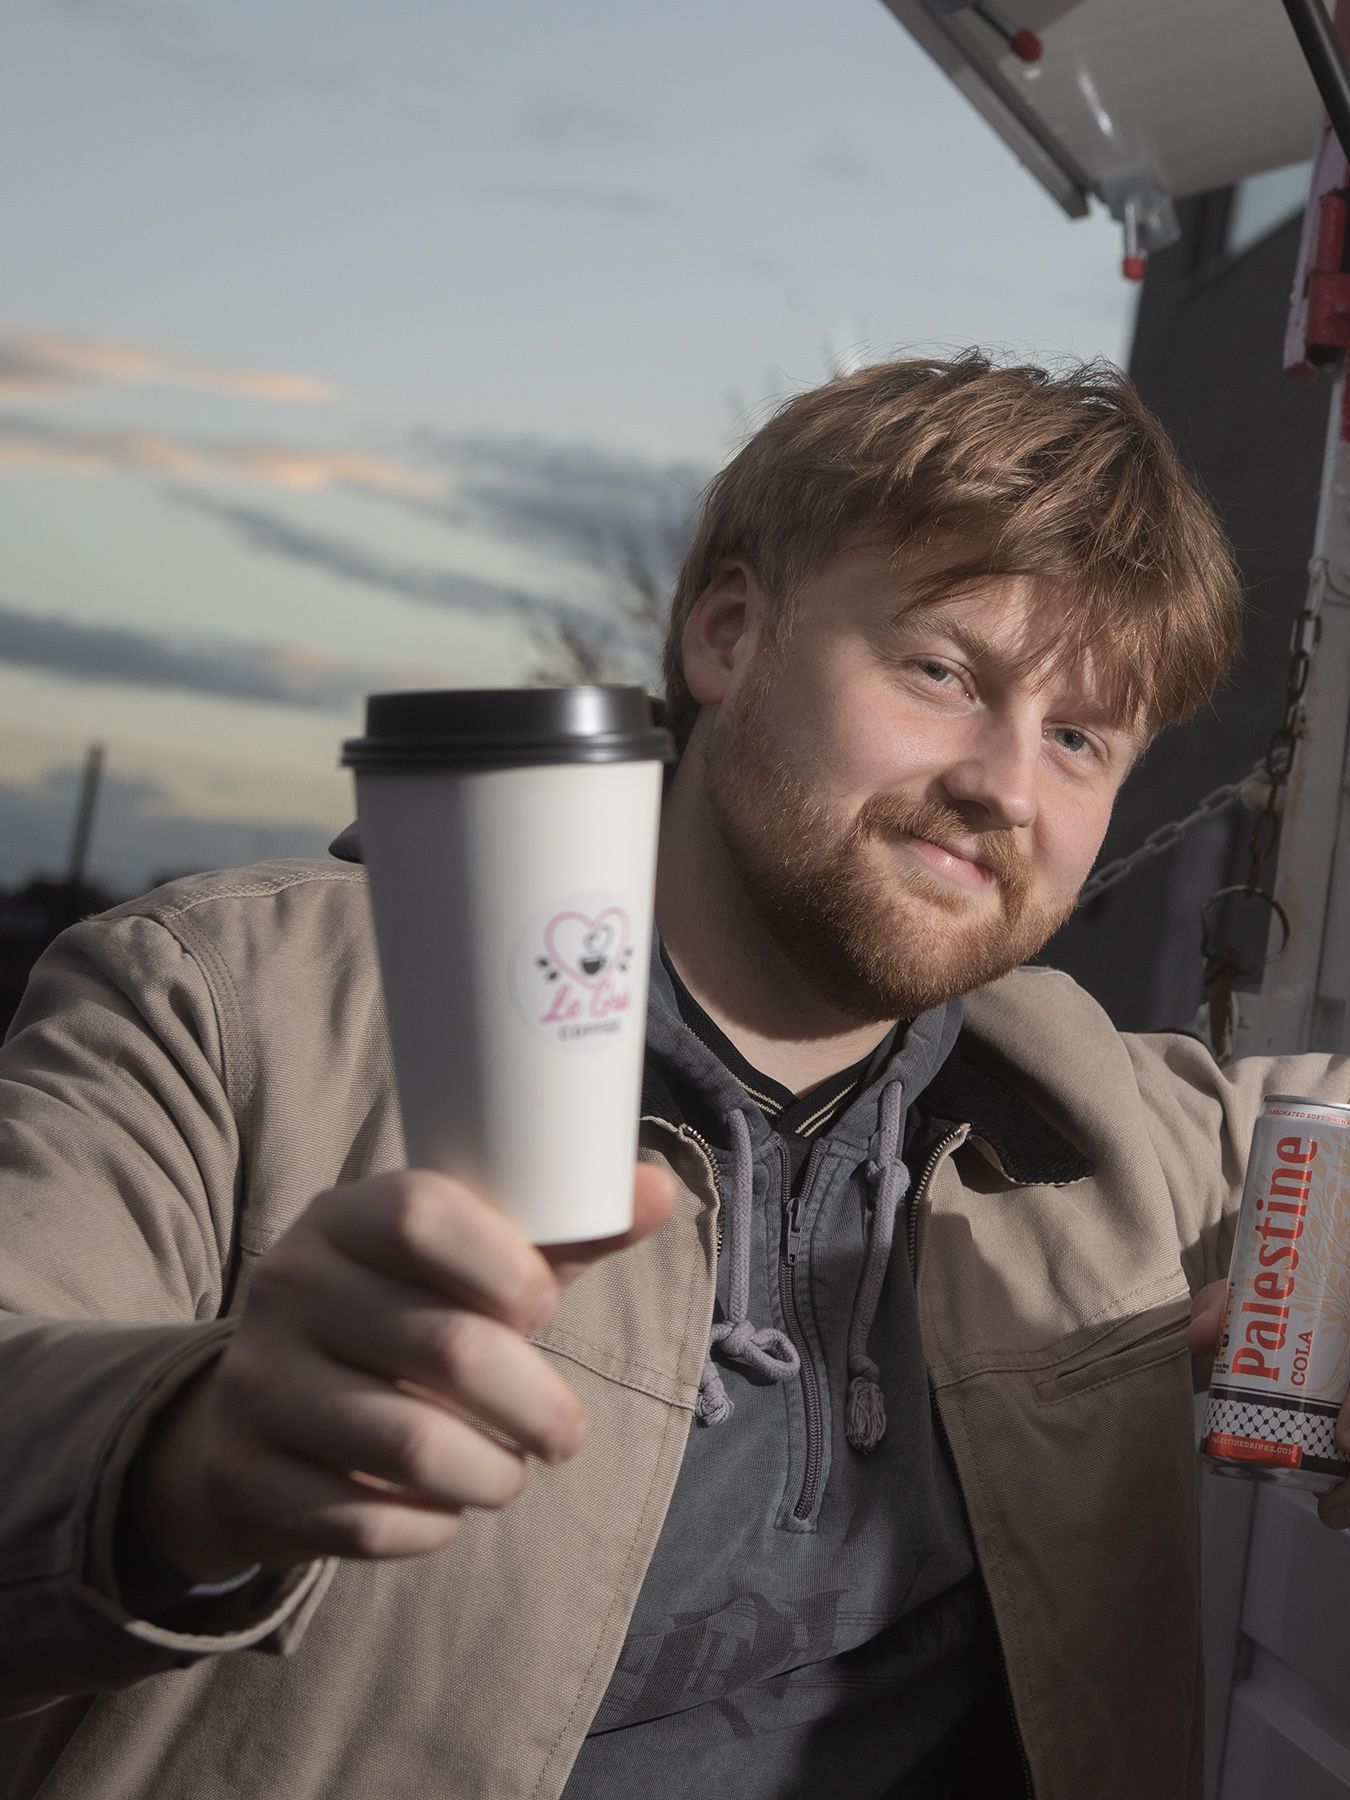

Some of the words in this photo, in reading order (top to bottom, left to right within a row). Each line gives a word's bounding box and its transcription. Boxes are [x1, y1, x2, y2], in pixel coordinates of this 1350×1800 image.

[1306, 1112, 1325, 1121] SOFT
[1231, 1136, 1318, 1382] Palestine
[1291, 1330, 1314, 1386] COLA
